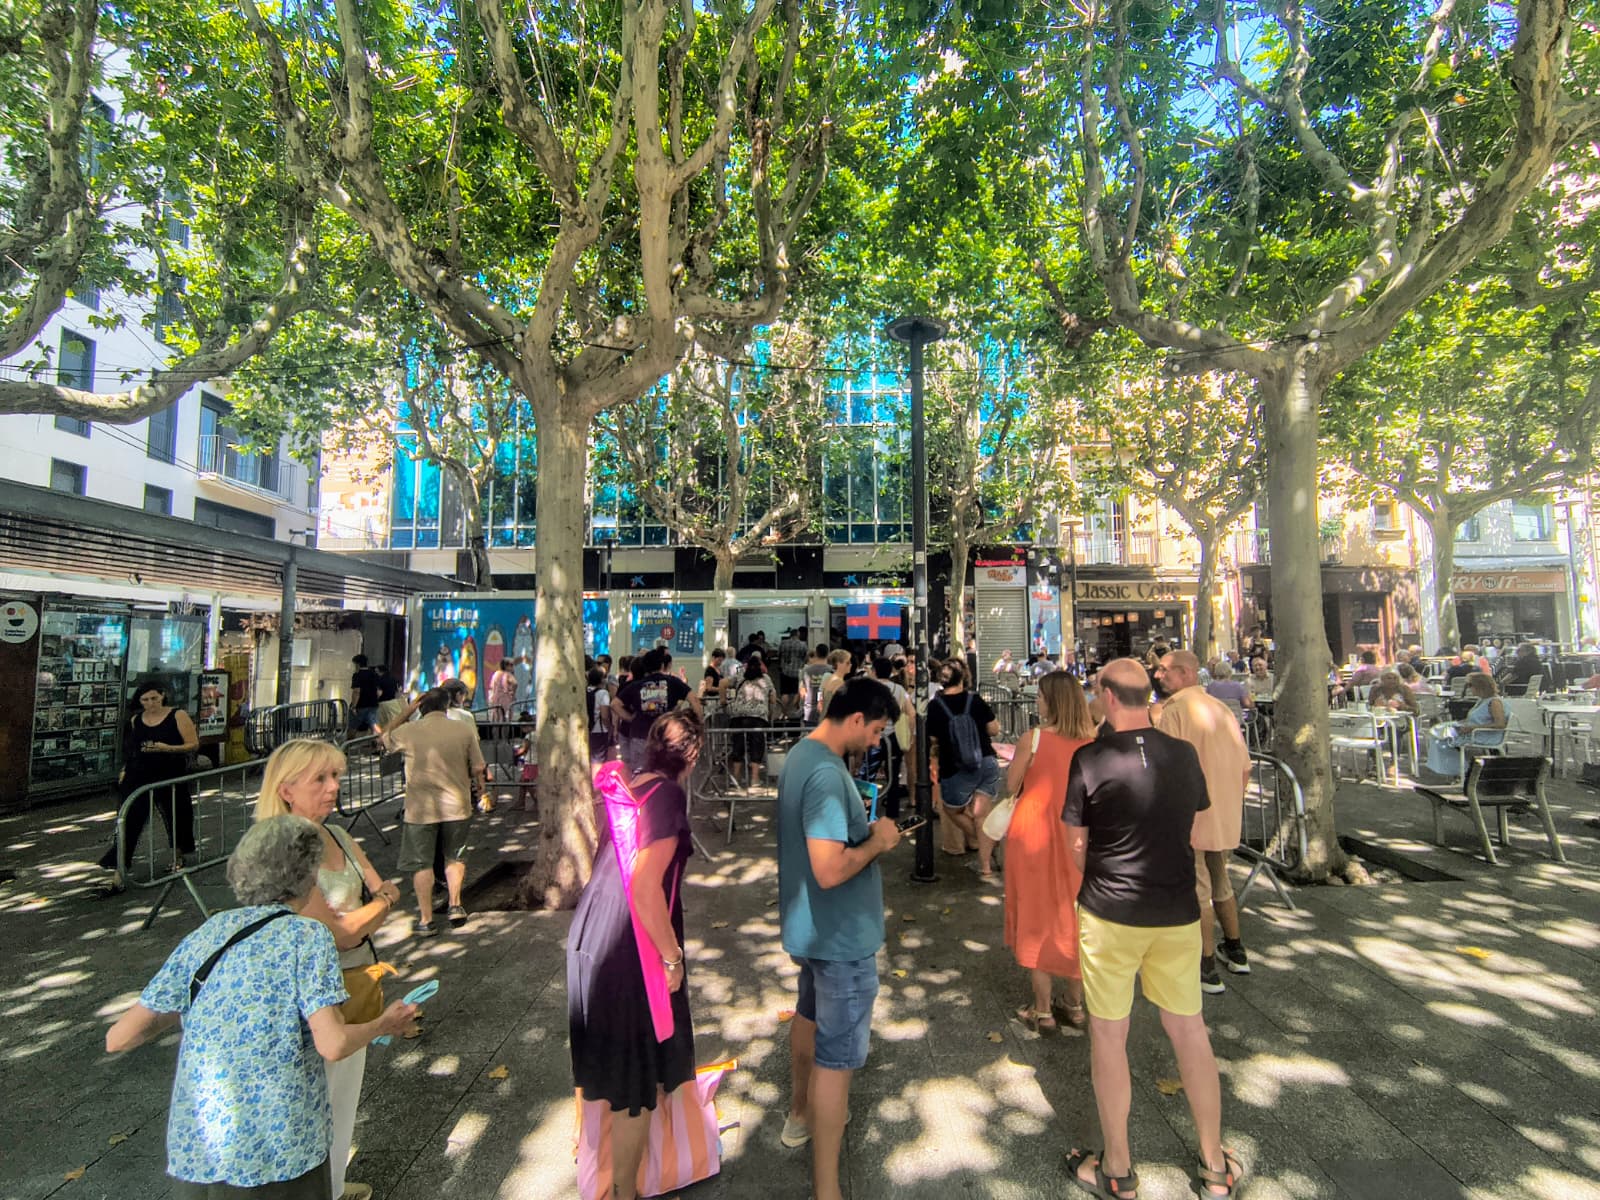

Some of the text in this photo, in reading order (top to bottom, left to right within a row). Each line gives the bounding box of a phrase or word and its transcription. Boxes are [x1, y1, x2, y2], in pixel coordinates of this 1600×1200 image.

[1498, 576, 1519, 589] IT
[1076, 583, 1132, 599] Classic
[432, 608, 445, 620] LA
